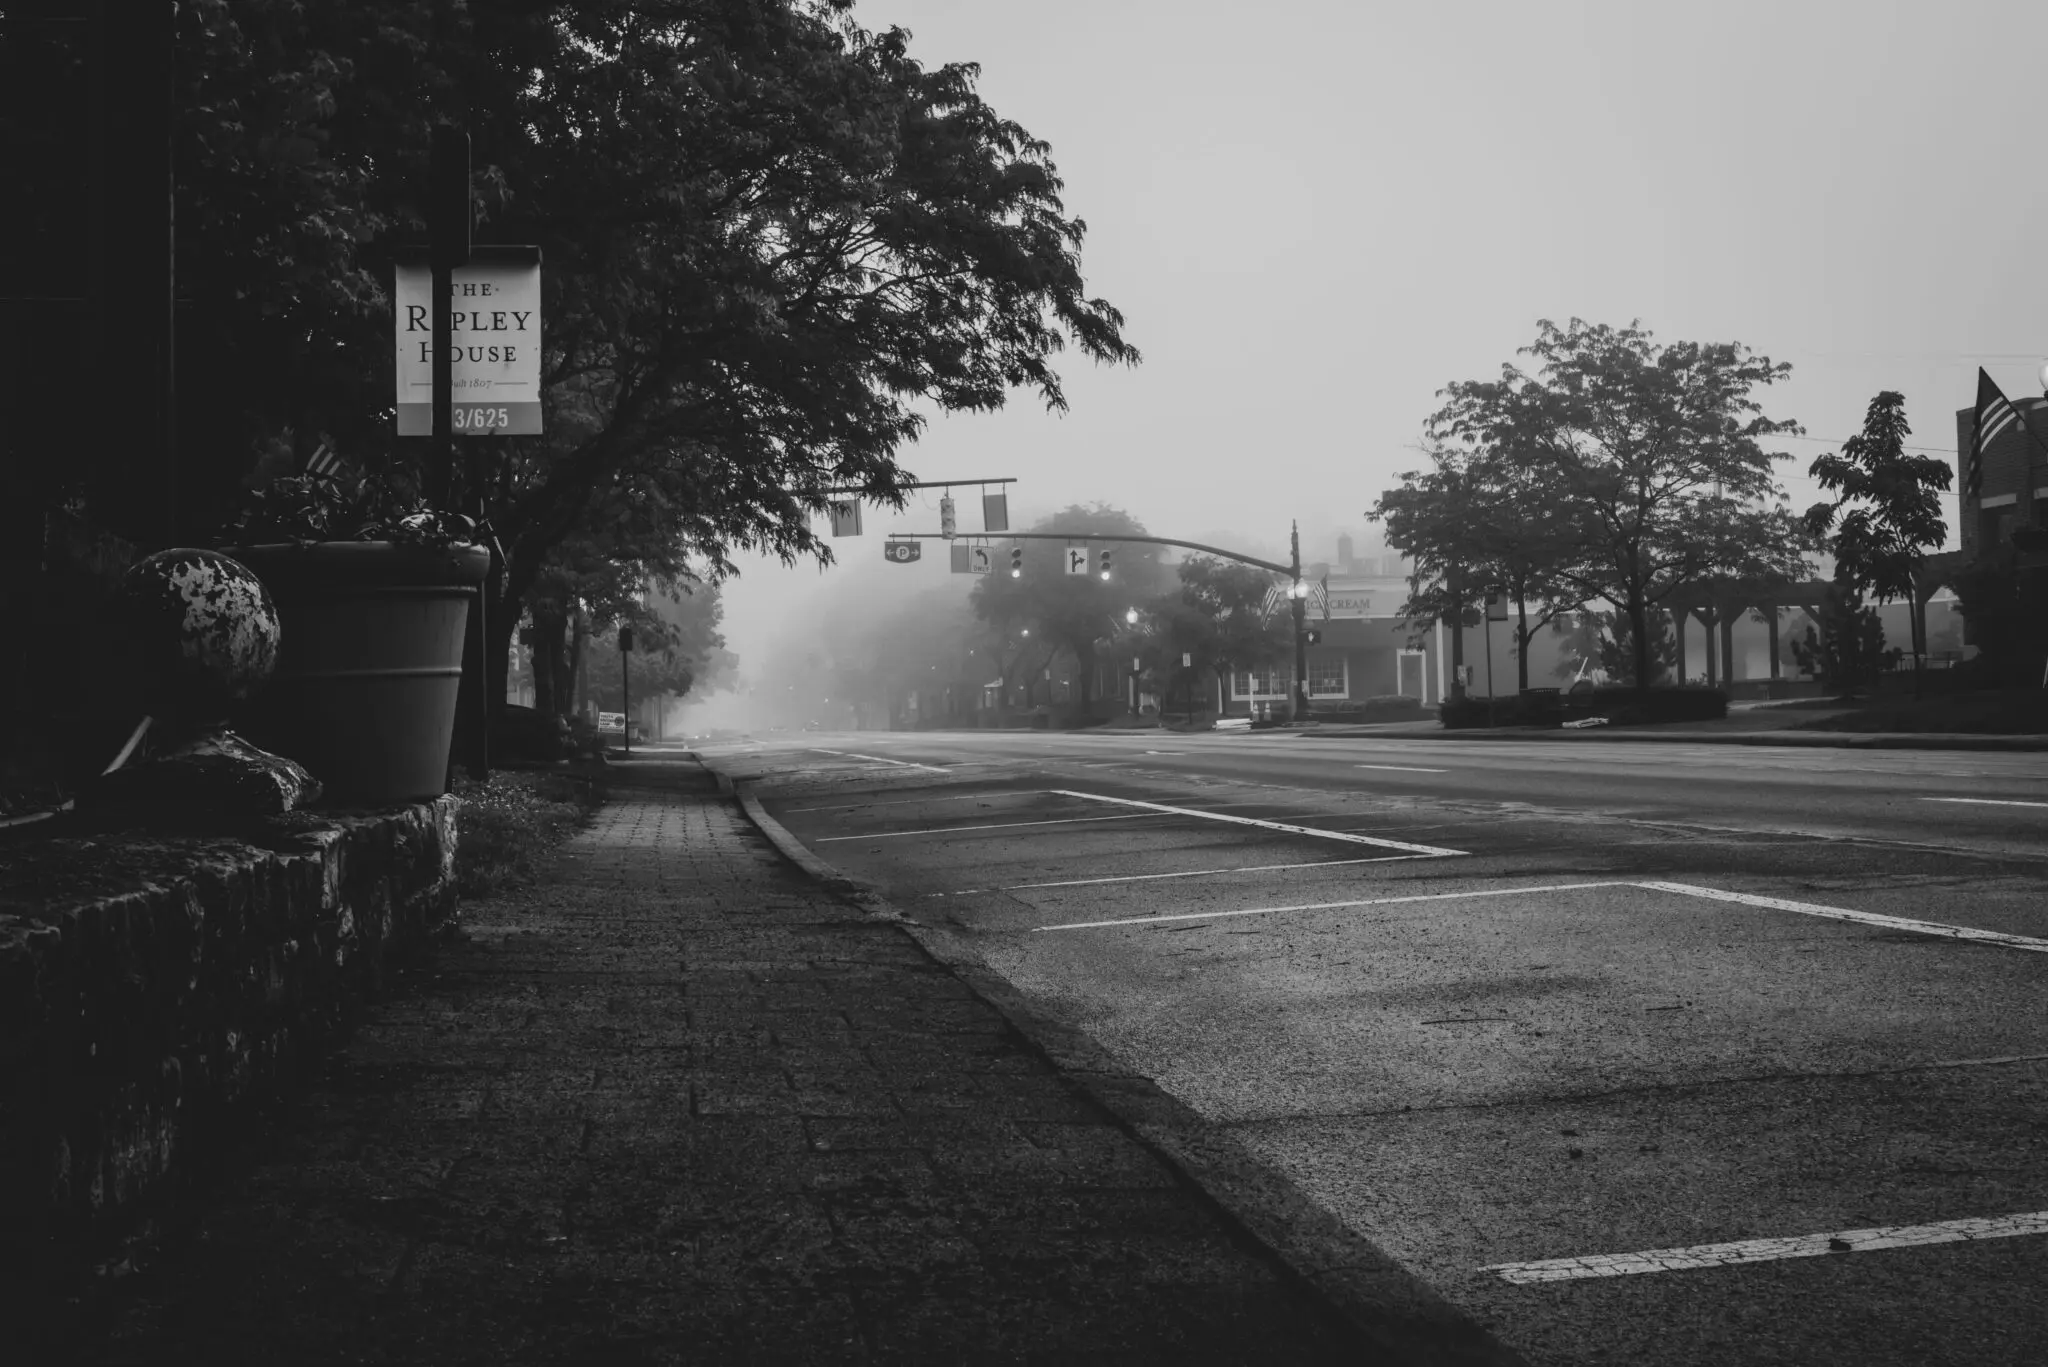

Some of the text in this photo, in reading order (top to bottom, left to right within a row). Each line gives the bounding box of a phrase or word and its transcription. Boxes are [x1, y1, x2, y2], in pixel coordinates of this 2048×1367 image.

[450, 283, 492, 297] THE
[405, 305, 532, 331] RPLEY
[418, 341, 517, 363] HOUSE
[451, 378, 493, 390] uilt 1807
[1329, 598, 1370, 610] CREAM
